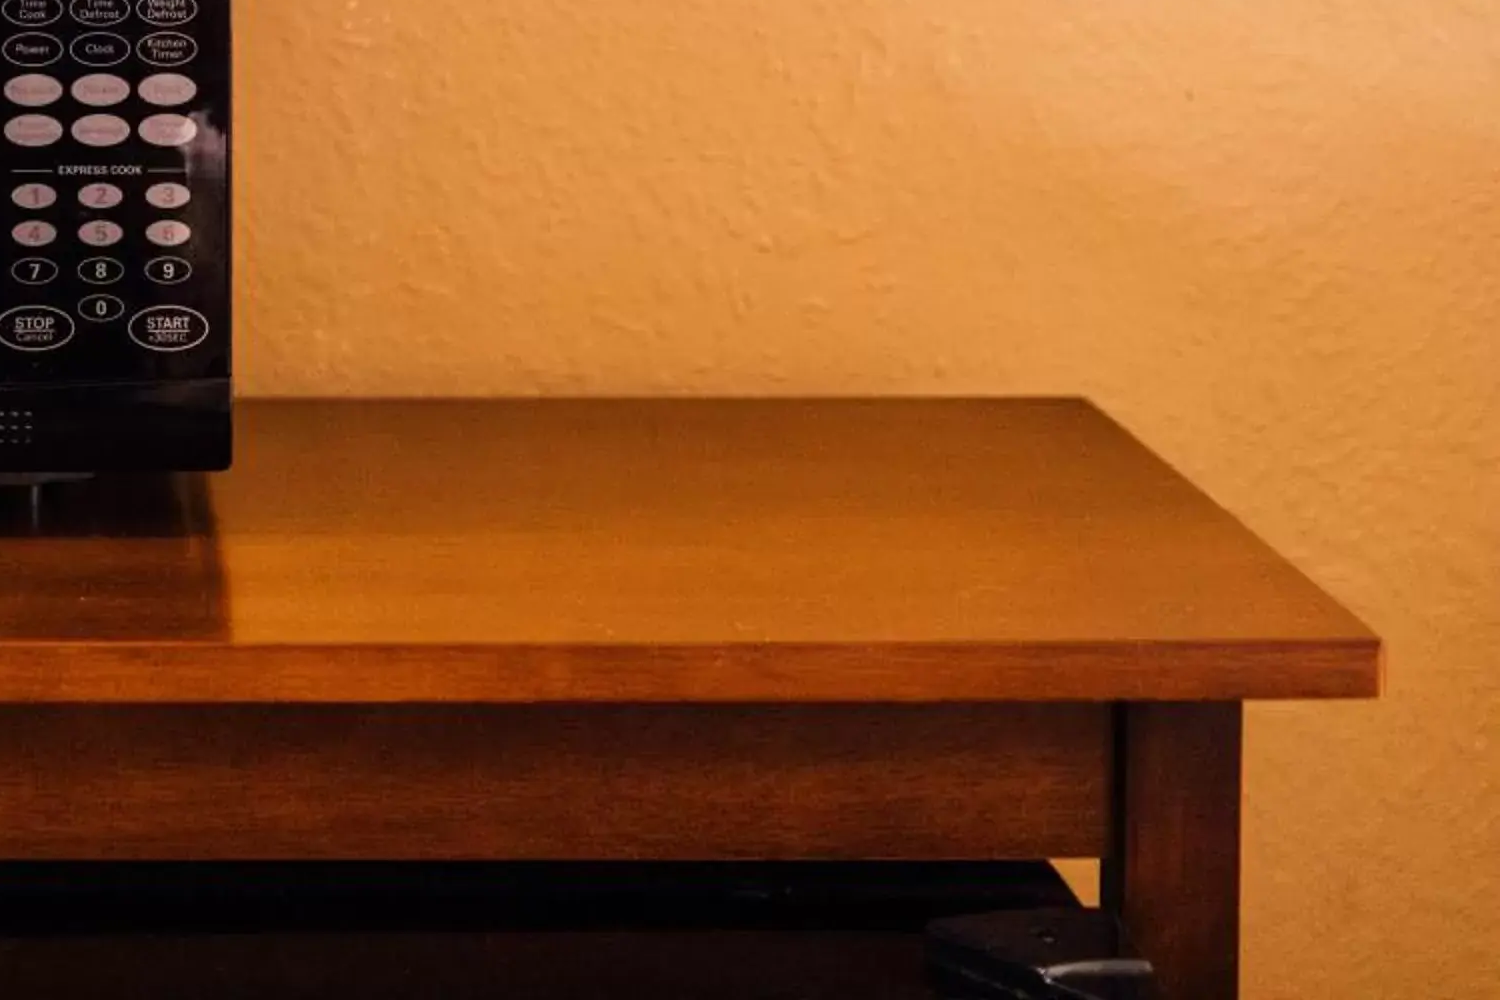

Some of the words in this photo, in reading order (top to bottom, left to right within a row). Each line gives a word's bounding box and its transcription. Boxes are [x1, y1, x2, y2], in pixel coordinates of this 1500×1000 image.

[19, 10, 46, 19] Cook
[80, 10, 119, 19] Defrost
[147, 10, 187, 19] Defrost
[15, 43, 49, 54] Power
[85, 43, 114, 54] Clock
[147, 38, 186, 48] Kitchen
[152, 49, 183, 60] Timer
[58, 165, 107, 176] EXPRESS
[111, 165, 142, 176] COOK
[30, 187, 40, 205] 1
[95, 187, 108, 203] 2
[163, 187, 175, 204] 3
[28, 225, 41, 241] 4
[95, 224, 108, 241] 5
[162, 224, 175, 241] 6
[29, 263, 41, 279] 7
[95, 262, 107, 279] 8
[162, 263, 175, 279] 9
[95, 300, 107, 315] 0
[15, 317, 55, 329] STOP
[147, 317, 190, 329] START
